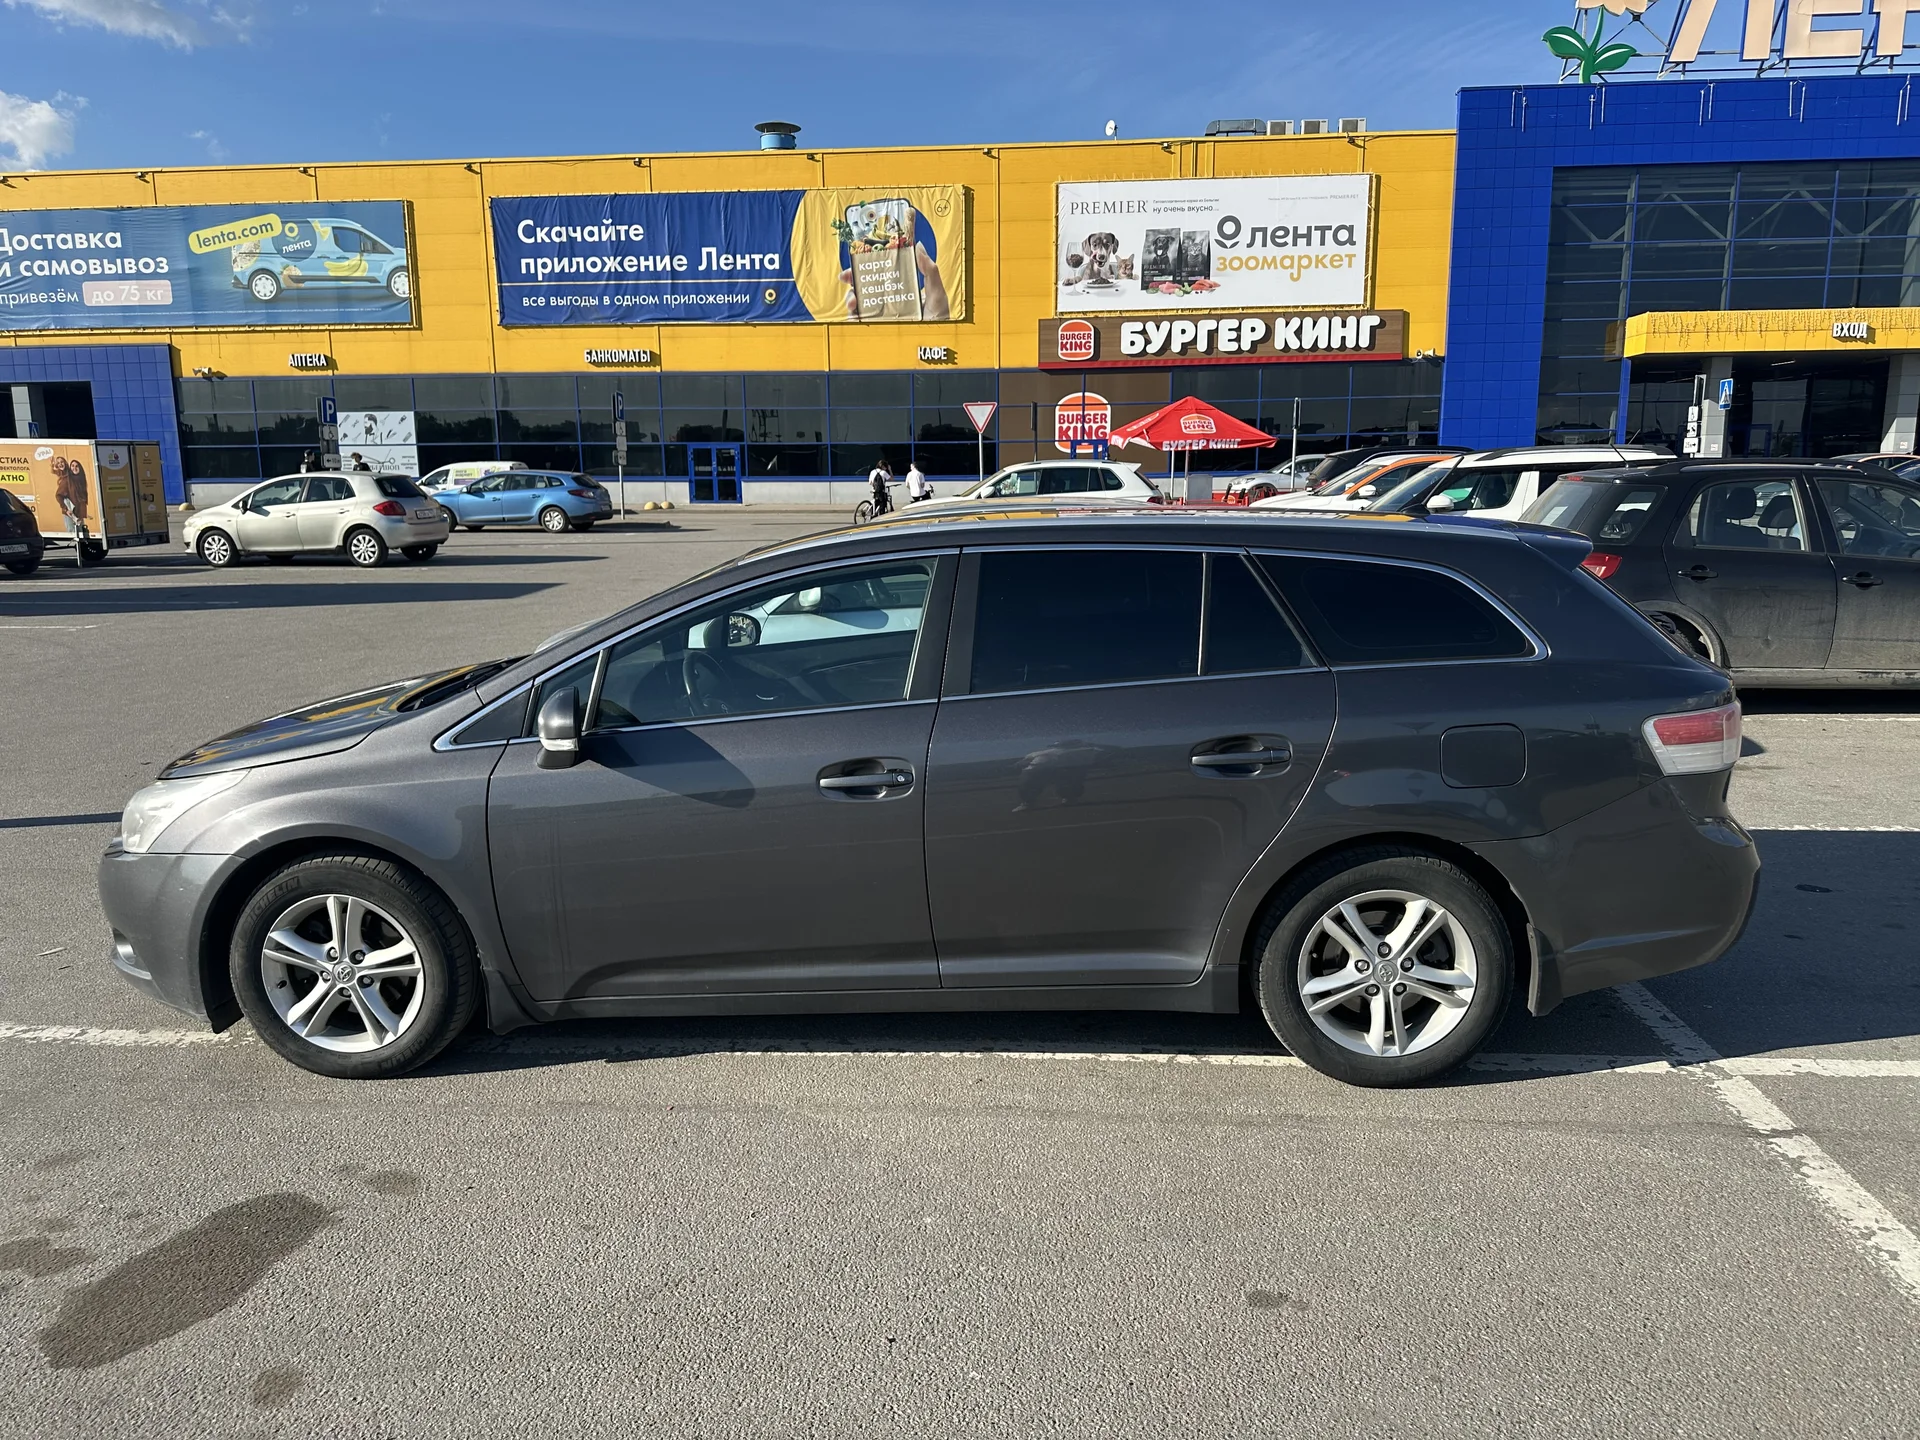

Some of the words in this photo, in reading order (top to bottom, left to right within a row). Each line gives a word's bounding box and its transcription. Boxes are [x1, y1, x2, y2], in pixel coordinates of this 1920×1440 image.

[1070, 200, 1148, 215] PREMIER
[196, 222, 274, 248] lenta.com
[517, 219, 644, 244] Скачайте
[1246, 224, 1357, 248] лента
[0, 228, 122, 256] Доставка
[282, 240, 312, 254] лента
[19, 257, 169, 277] самовывоз
[520, 254, 688, 281] приложение
[698, 246, 780, 270] Лента
[858, 259, 892, 272] карта
[1215, 253, 1357, 282] зоомаркет
[860, 269, 900, 283] скидки
[861, 280, 905, 295] кешбэк
[0, 288, 79, 308] привезём
[92, 290, 114, 304] до
[118, 285, 140, 301] 75
[146, 289, 164, 300] кг
[522, 297, 545, 307] все
[550, 296, 599, 308] выгоды
[603, 297, 610, 305] в
[614, 294, 659, 307] одном
[663, 293, 750, 309] приложении
[863, 291, 915, 308] доставка
[1060, 332, 1092, 341] BURGER
[1120, 317, 1266, 355] БУРГЕР
[1274, 315, 1381, 350] КИНГ
[1832, 322, 1868, 338] ВХОД
[917, 346, 948, 360] КАФЕ
[1060, 341, 1092, 352] KING
[288, 353, 327, 367] АПТЕКА
[584, 349, 651, 363] БАНКОМАТЫ
[1058, 413, 1108, 425] BURGER
[1058, 425, 1108, 441] KING
[1162, 439, 1207, 451] БУРГЕР
[1209, 438, 1242, 449] КИНГ
[0, 474, 25, 482] АТНО
